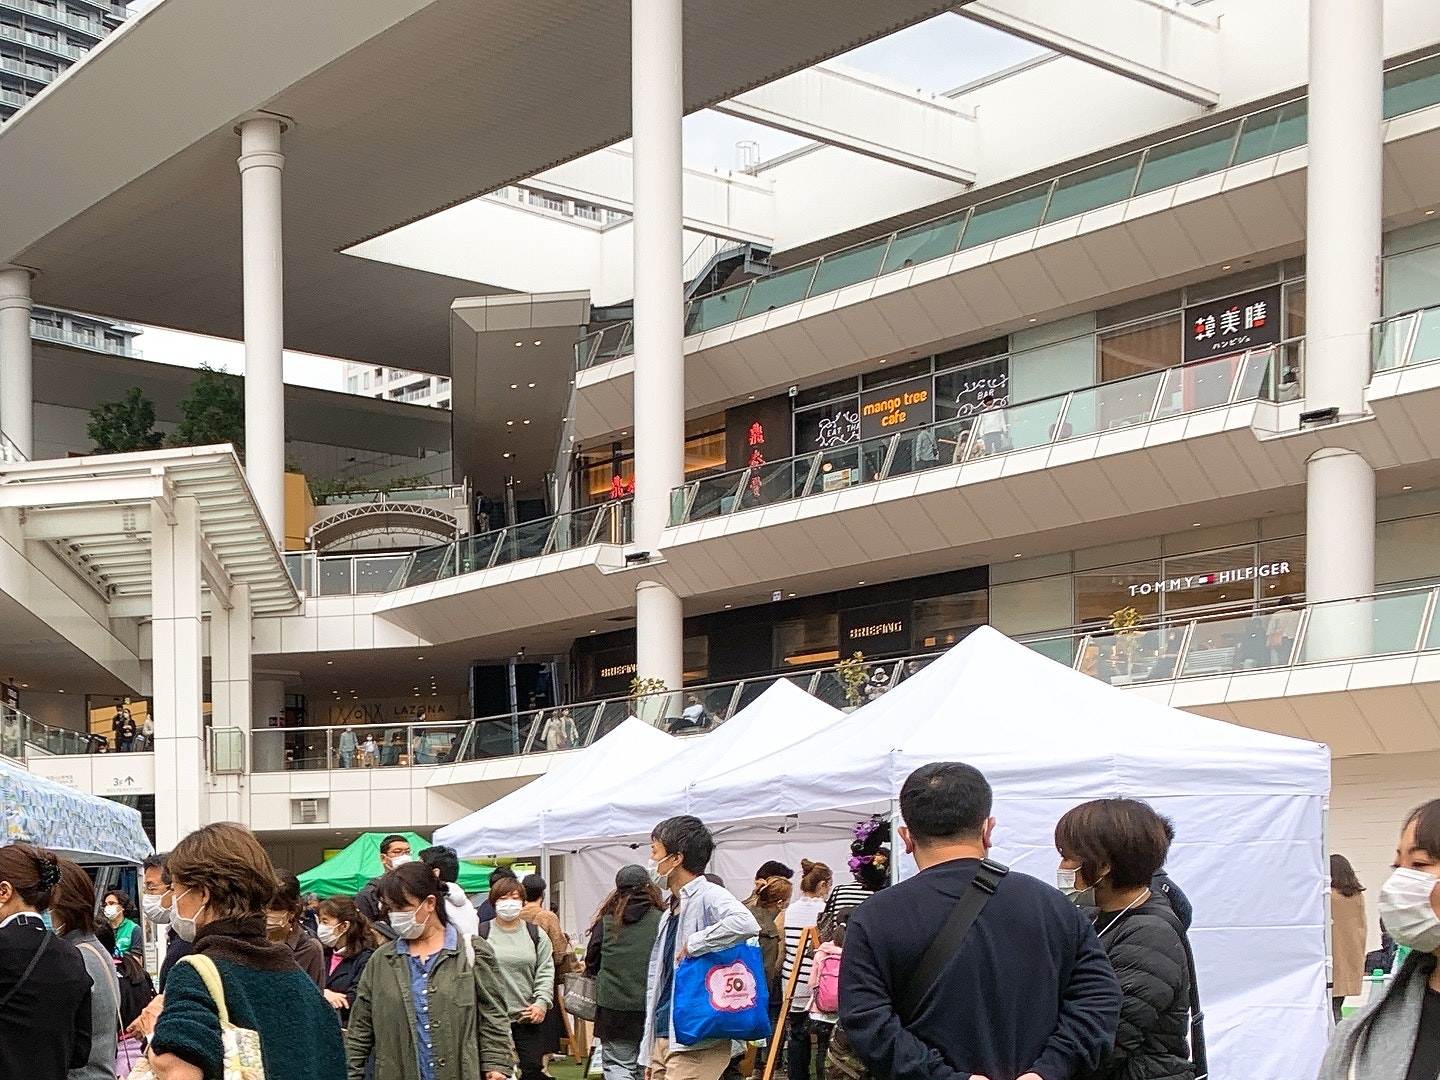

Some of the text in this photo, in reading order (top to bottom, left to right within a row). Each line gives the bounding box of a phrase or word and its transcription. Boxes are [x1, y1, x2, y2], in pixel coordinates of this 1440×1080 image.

[863, 390, 928, 416] mango tree
[977, 388, 995, 400] BAR
[881, 411, 907, 427] cafe
[827, 426, 842, 438] EAT
[1129, 561, 1291, 597] TOMMY HILFIGER
[849, 620, 902, 640] BRIEFING
